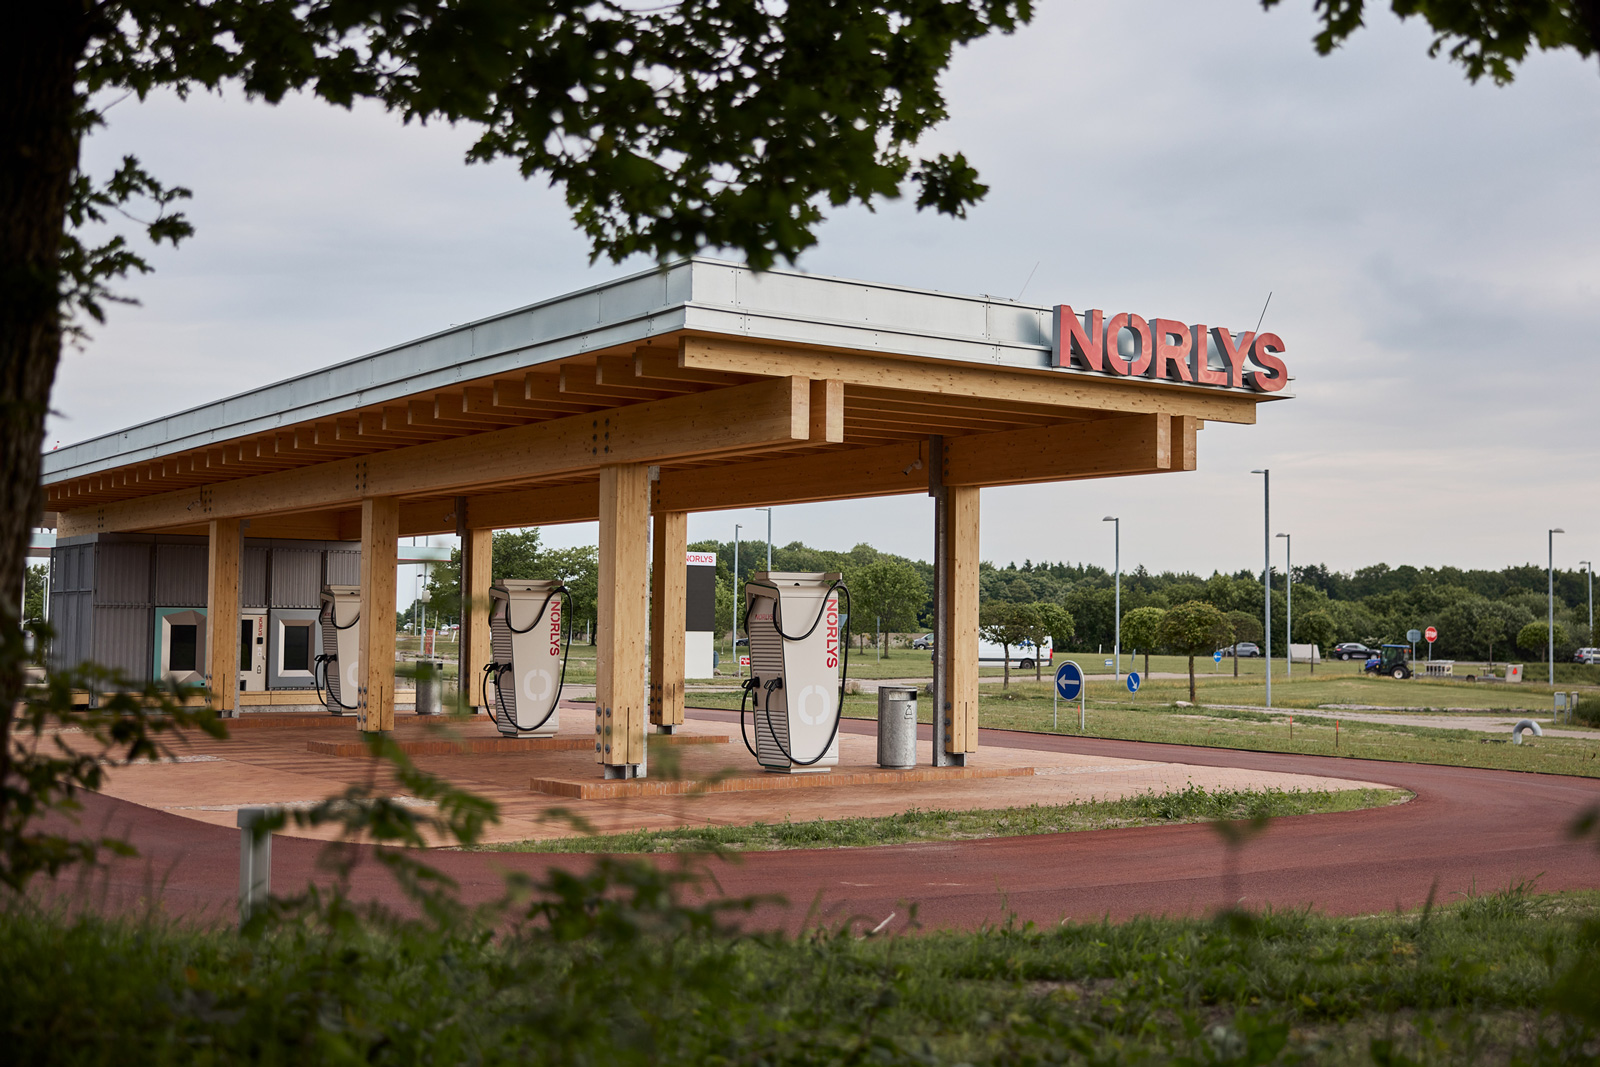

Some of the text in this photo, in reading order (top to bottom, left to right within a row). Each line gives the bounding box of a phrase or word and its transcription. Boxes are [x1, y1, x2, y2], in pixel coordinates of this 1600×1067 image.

[1052, 304, 1288, 392] NORLYS
[549, 601, 561, 656] NORLYS
[826, 599, 838, 668] NORLYS
